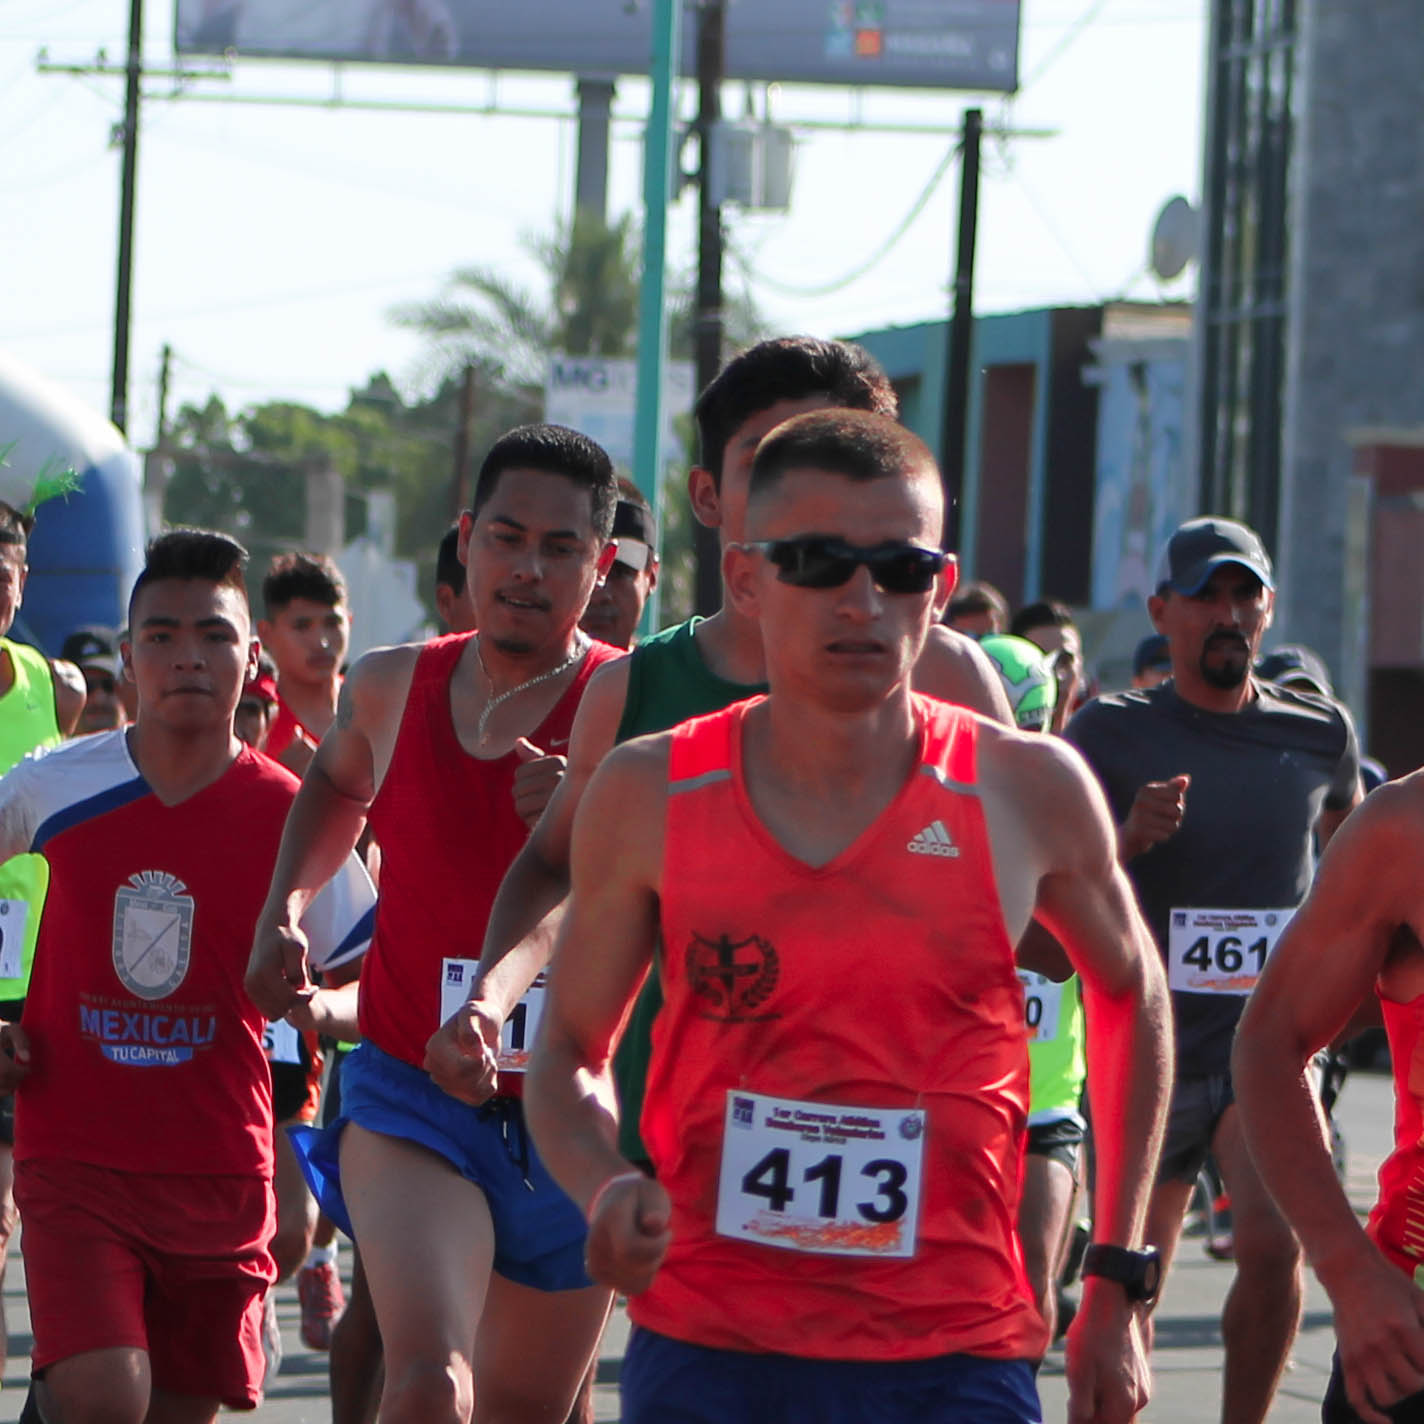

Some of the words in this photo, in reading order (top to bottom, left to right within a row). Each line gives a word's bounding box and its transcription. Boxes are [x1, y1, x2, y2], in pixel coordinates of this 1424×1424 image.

[908, 842, 958, 857] adidas
[1182, 936, 1268, 973] 461
[80, 1005, 216, 1044] MEXICALI
[112, 1048, 128, 1060] TU
[129, 1048, 179, 1063] CAPITAL
[741, 1147, 908, 1224] 413
